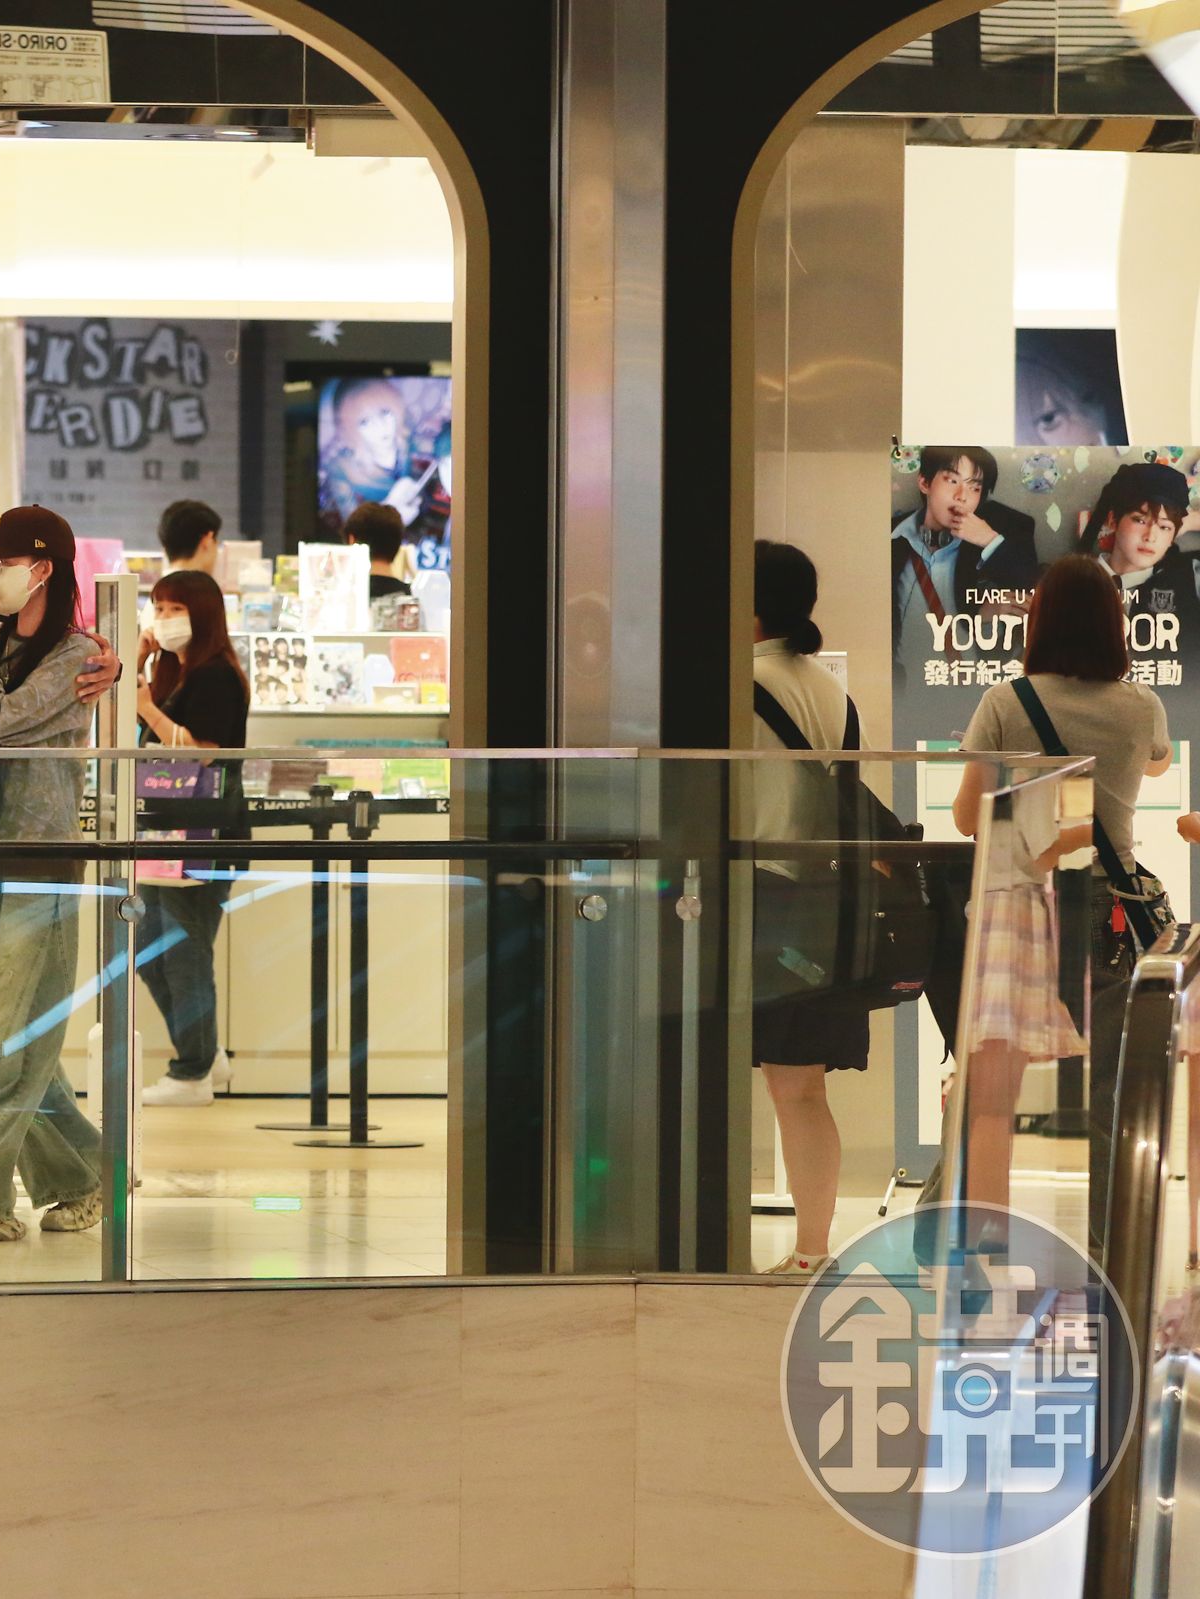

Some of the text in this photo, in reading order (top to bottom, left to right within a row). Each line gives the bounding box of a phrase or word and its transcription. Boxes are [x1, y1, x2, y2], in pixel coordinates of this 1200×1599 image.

[965, 588, 1011, 605] FLARE
[1015, 588, 1026, 605] U
[1119, 659, 1183, 686] 活動
